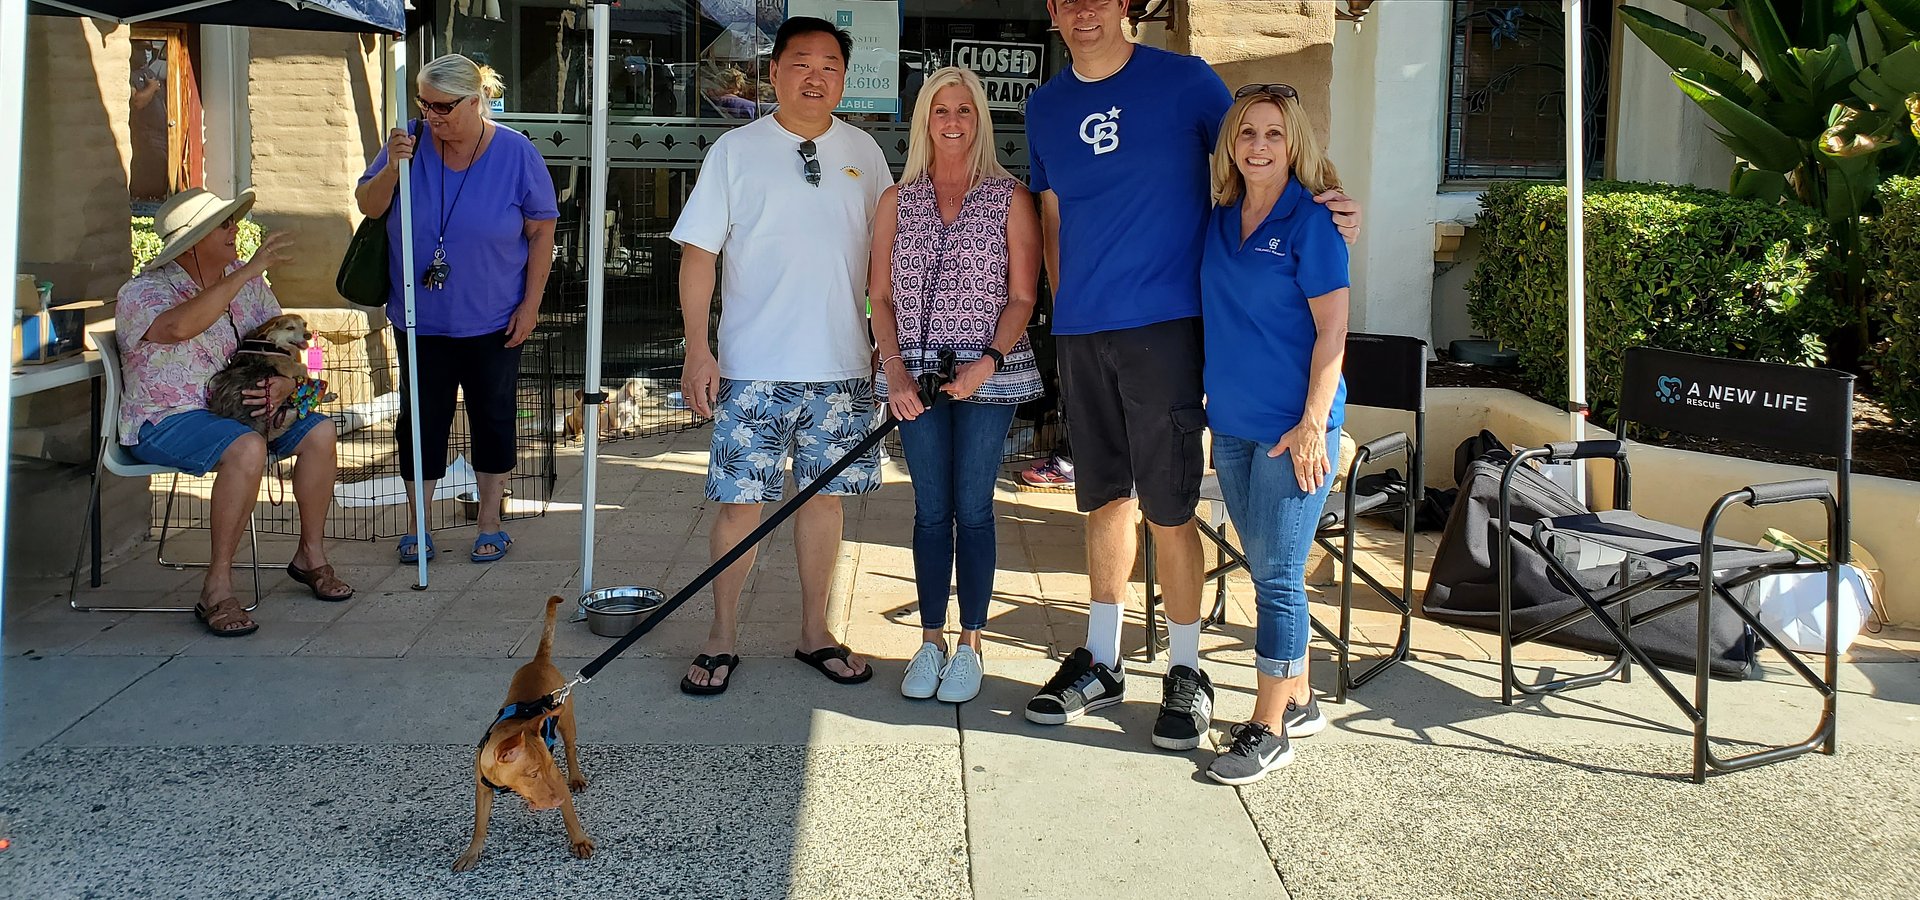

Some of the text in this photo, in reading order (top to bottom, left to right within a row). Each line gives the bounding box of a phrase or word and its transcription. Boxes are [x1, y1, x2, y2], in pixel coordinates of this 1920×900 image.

[957, 46, 1037, 74] CLOSED
[845, 77, 890, 90] 4.6103
[985, 80, 1037, 102] RADO
[838, 100, 874, 109] LABLE
[1686, 397, 1721, 410] RESCUE
[1687, 382, 1808, 413] A NEW LIFE
